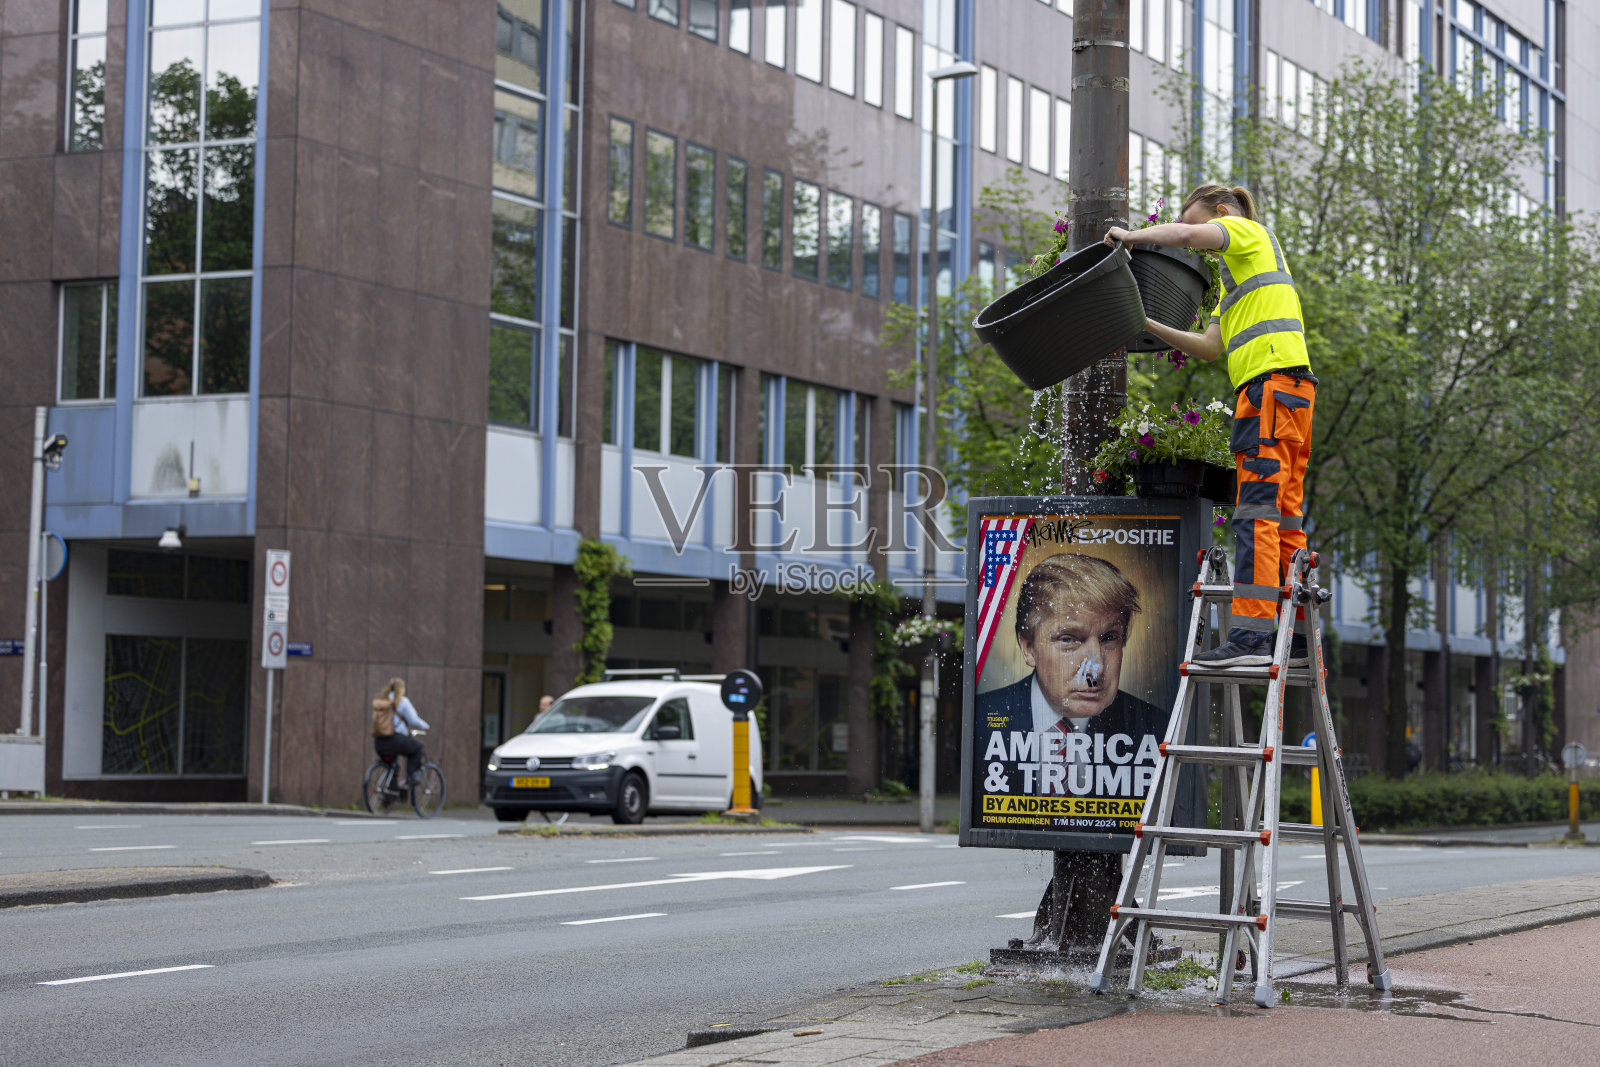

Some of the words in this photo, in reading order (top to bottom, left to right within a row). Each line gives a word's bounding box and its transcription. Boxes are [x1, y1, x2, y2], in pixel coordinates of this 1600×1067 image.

[1078, 529, 1174, 545] EXPOSITIE
[985, 530, 1017, 587] F
[984, 731, 1160, 764] AMERICA
[984, 762, 1009, 792] &
[1018, 763, 1156, 796] TRUMP
[986, 797, 1004, 811] BY
[1007, 799, 1070, 813] ANDRES
[1074, 801, 1145, 815] SERRAN
[983, 816, 1006, 824] FORUM
[1007, 817, 1050, 825] GRONINGEN
[1053, 818, 1068, 826] T/M
[1095, 819, 1116, 827] 2024
